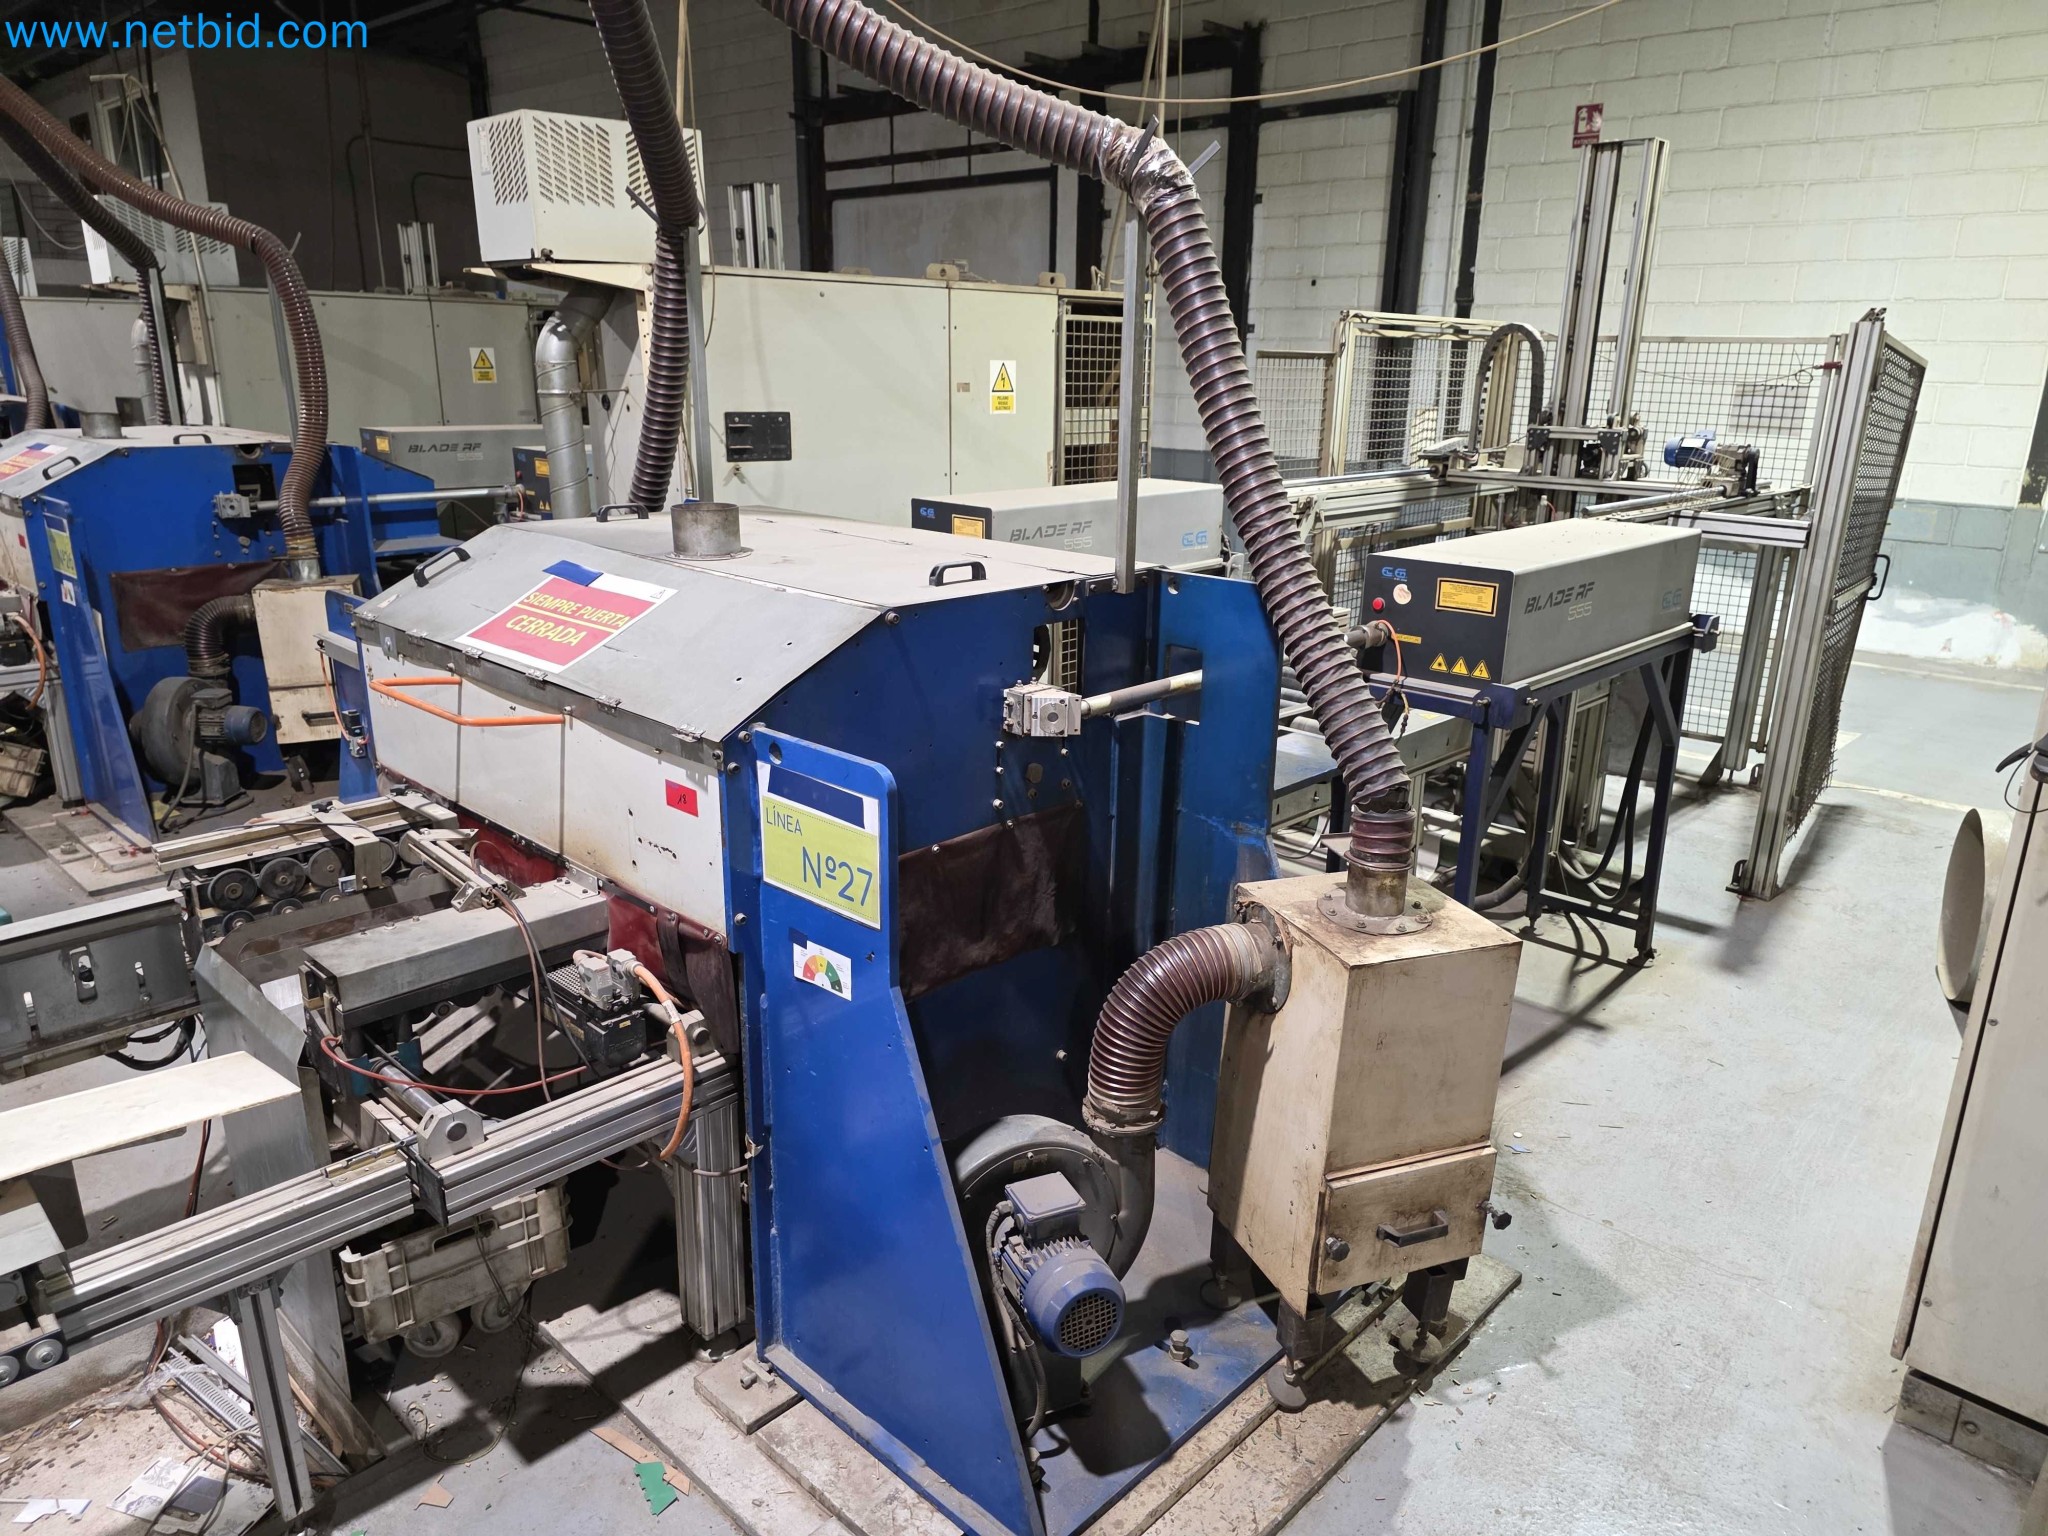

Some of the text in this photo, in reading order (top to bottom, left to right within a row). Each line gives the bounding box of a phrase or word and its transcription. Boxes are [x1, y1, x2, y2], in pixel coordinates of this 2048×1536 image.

[408, 442, 482, 453] BLADE RF
[1009, 519, 1093, 542] BLADE RF
[523, 591, 632, 629] SIEMPRE PUERTA
[1524, 581, 1595, 615] BLADE RF
[505, 614, 588, 647] CERRADA
[765, 805, 803, 836] LÍNEA
[802, 846, 873, 907] Nº27
